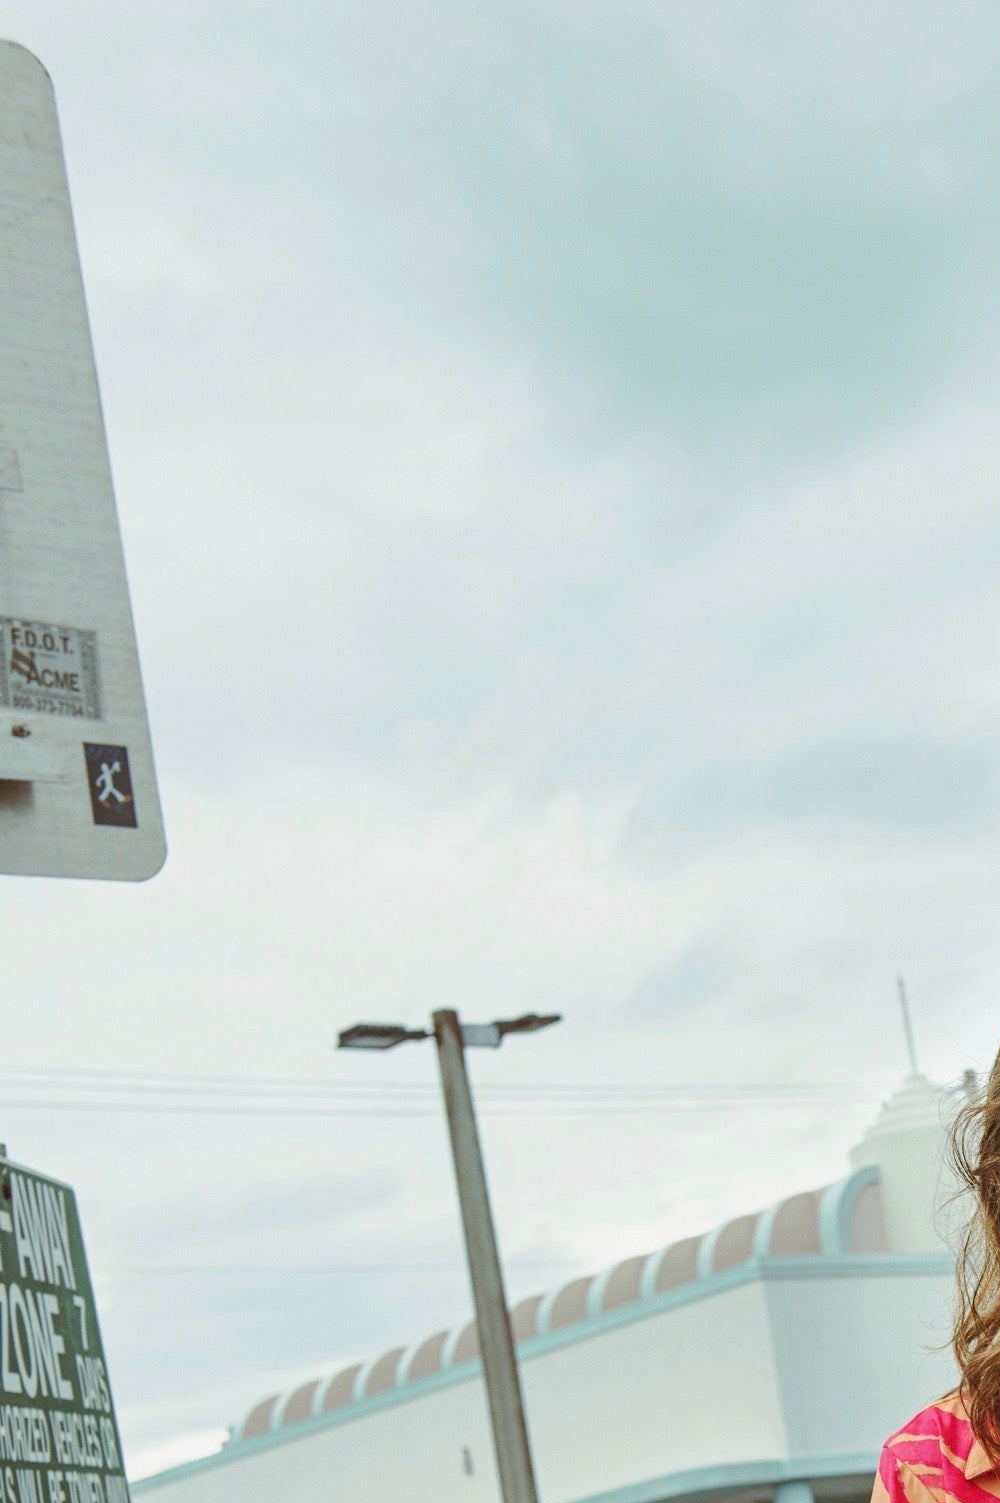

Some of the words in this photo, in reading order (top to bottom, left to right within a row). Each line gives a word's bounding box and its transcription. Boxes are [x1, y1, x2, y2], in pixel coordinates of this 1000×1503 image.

[27, 655, 80, 692] ACME
[0, 1171, 77, 1291] -AWAY
[73, 1295, 89, 1351] 7
[76, 1353, 111, 1414] DAYS
[0, 1403, 51, 1463] HORIZED
[50, 1410, 103, 1468] VEHICLES
[100, 1415, 120, 1470] OR
